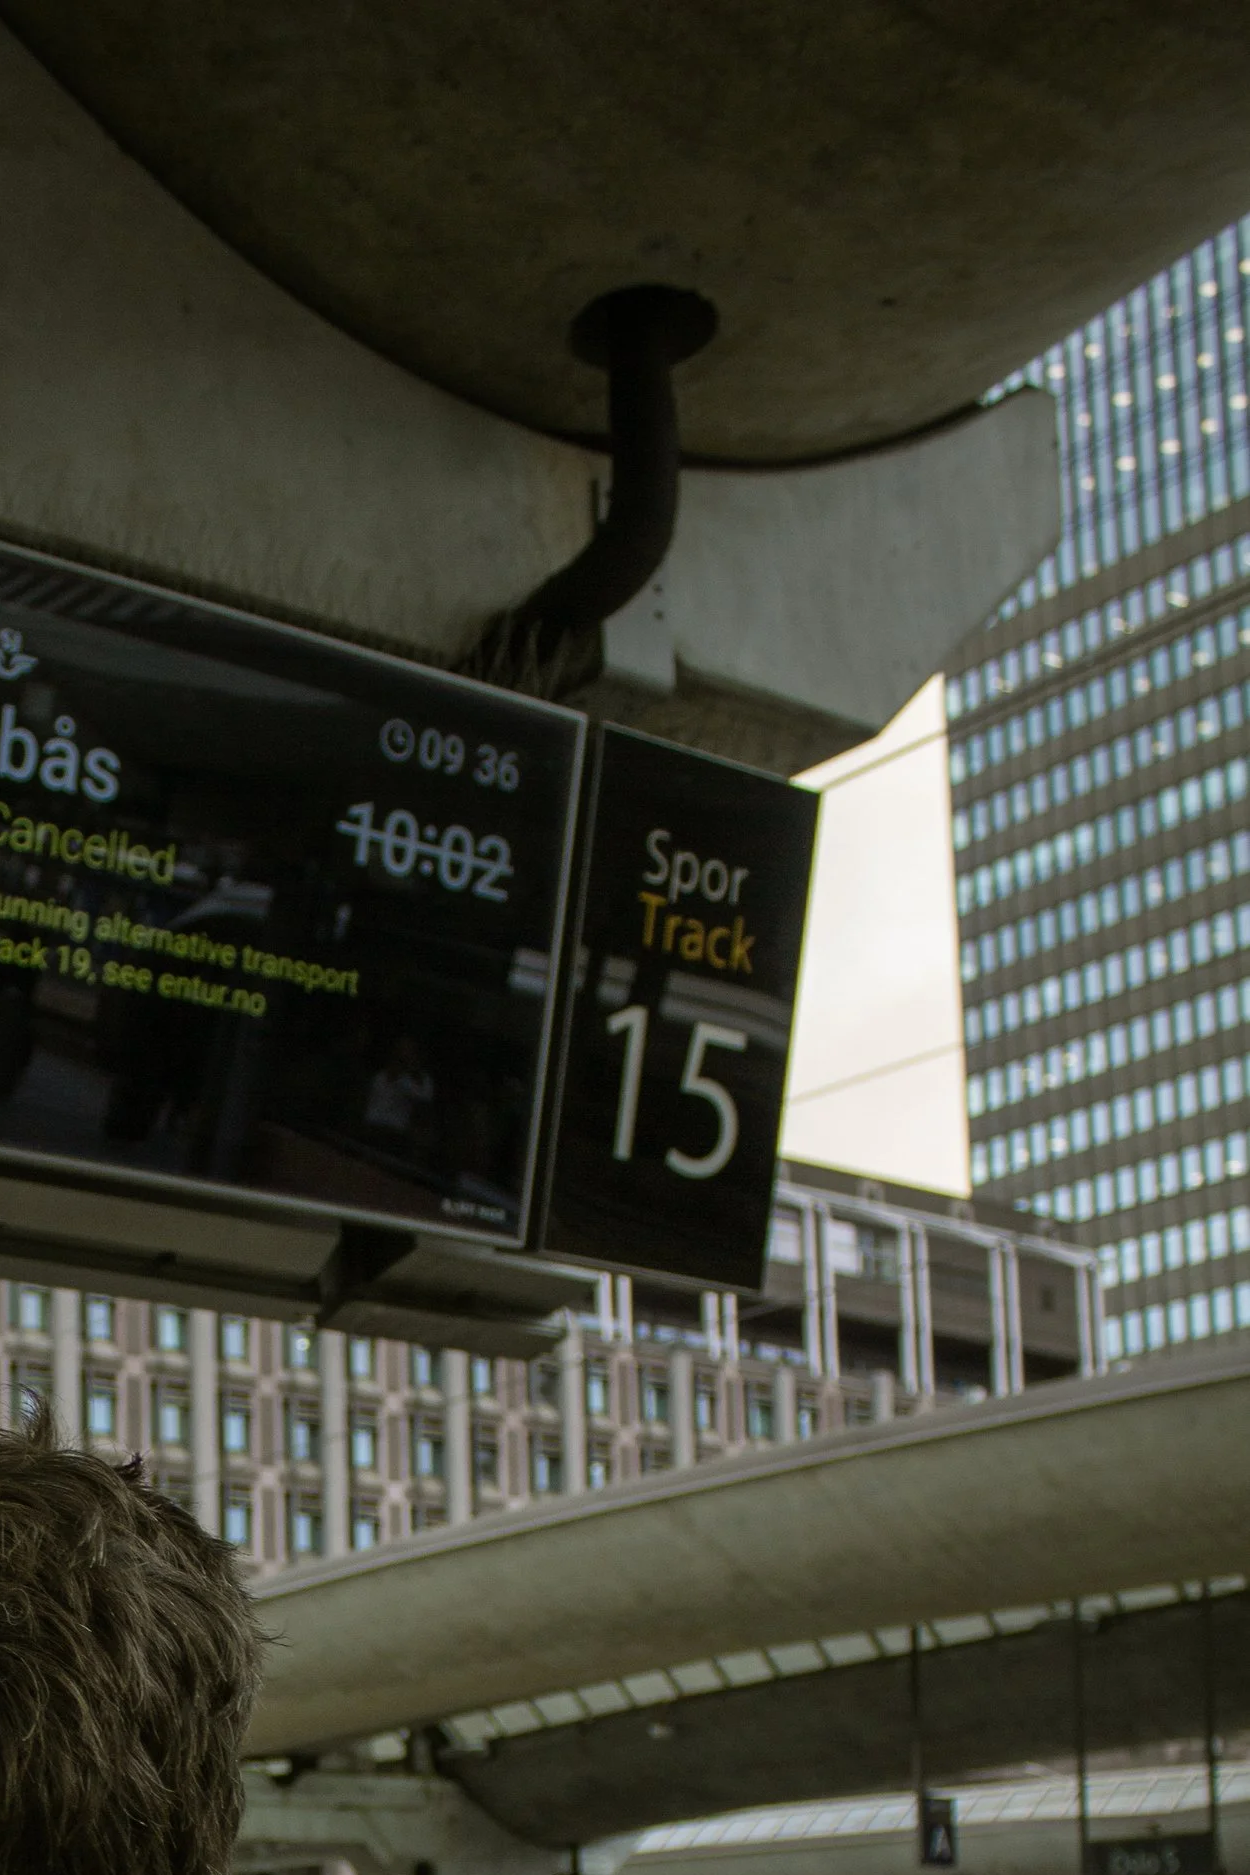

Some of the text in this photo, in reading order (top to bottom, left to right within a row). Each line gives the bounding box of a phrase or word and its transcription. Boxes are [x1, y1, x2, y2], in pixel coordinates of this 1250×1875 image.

[338, 801, 514, 904] 10:02
[642, 827, 750, 905] Spor
[93, 911, 238, 969] alternative
[241, 944, 360, 999] transport
[637, 890, 757, 974] Track
[56, 945, 97, 986] 19,
[101, 959, 154, 995] see
[156, 971, 270, 1018] entur.no
[605, 1003, 748, 1181] 15
